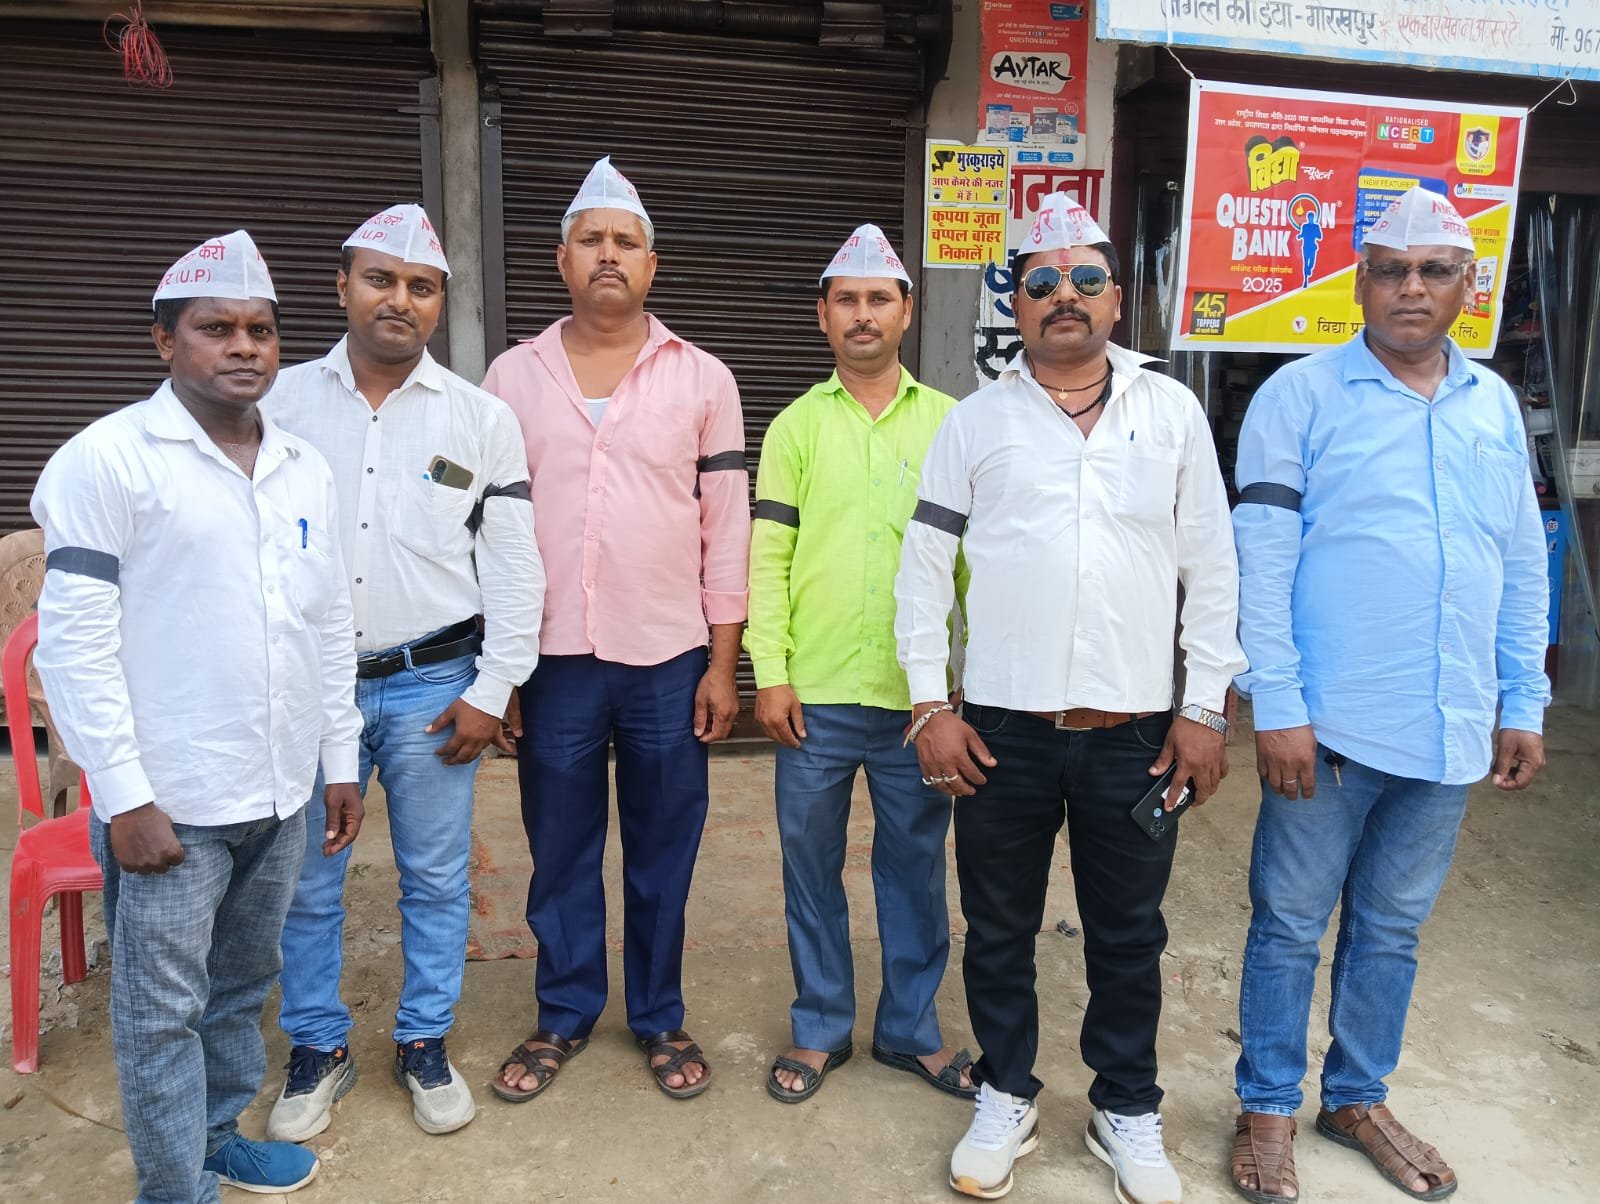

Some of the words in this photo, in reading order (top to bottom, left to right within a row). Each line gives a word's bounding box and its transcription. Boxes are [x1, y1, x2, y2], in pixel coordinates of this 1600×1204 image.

[1379, 124, 1434, 142] NCERT
[932, 177, 949, 187] आप
[972, 176, 983, 188] की
[985, 179, 1004, 189] नजर
[932, 211, 969, 227] कृपया
[973, 212, 1001, 229] जूता
[1216, 193, 1336, 232] QUESTION
[931, 229, 968, 241] चप्पल
[972, 230, 1002, 243] बाहर
[1232, 228, 1291, 260] BANK
[199, 239, 227, 261] करो
[939, 244, 983, 260] निकालें
[1242, 276, 1283, 293] 2025
[1193, 293, 1225, 318] 45
[1317, 317, 1347, 336] विद्या
